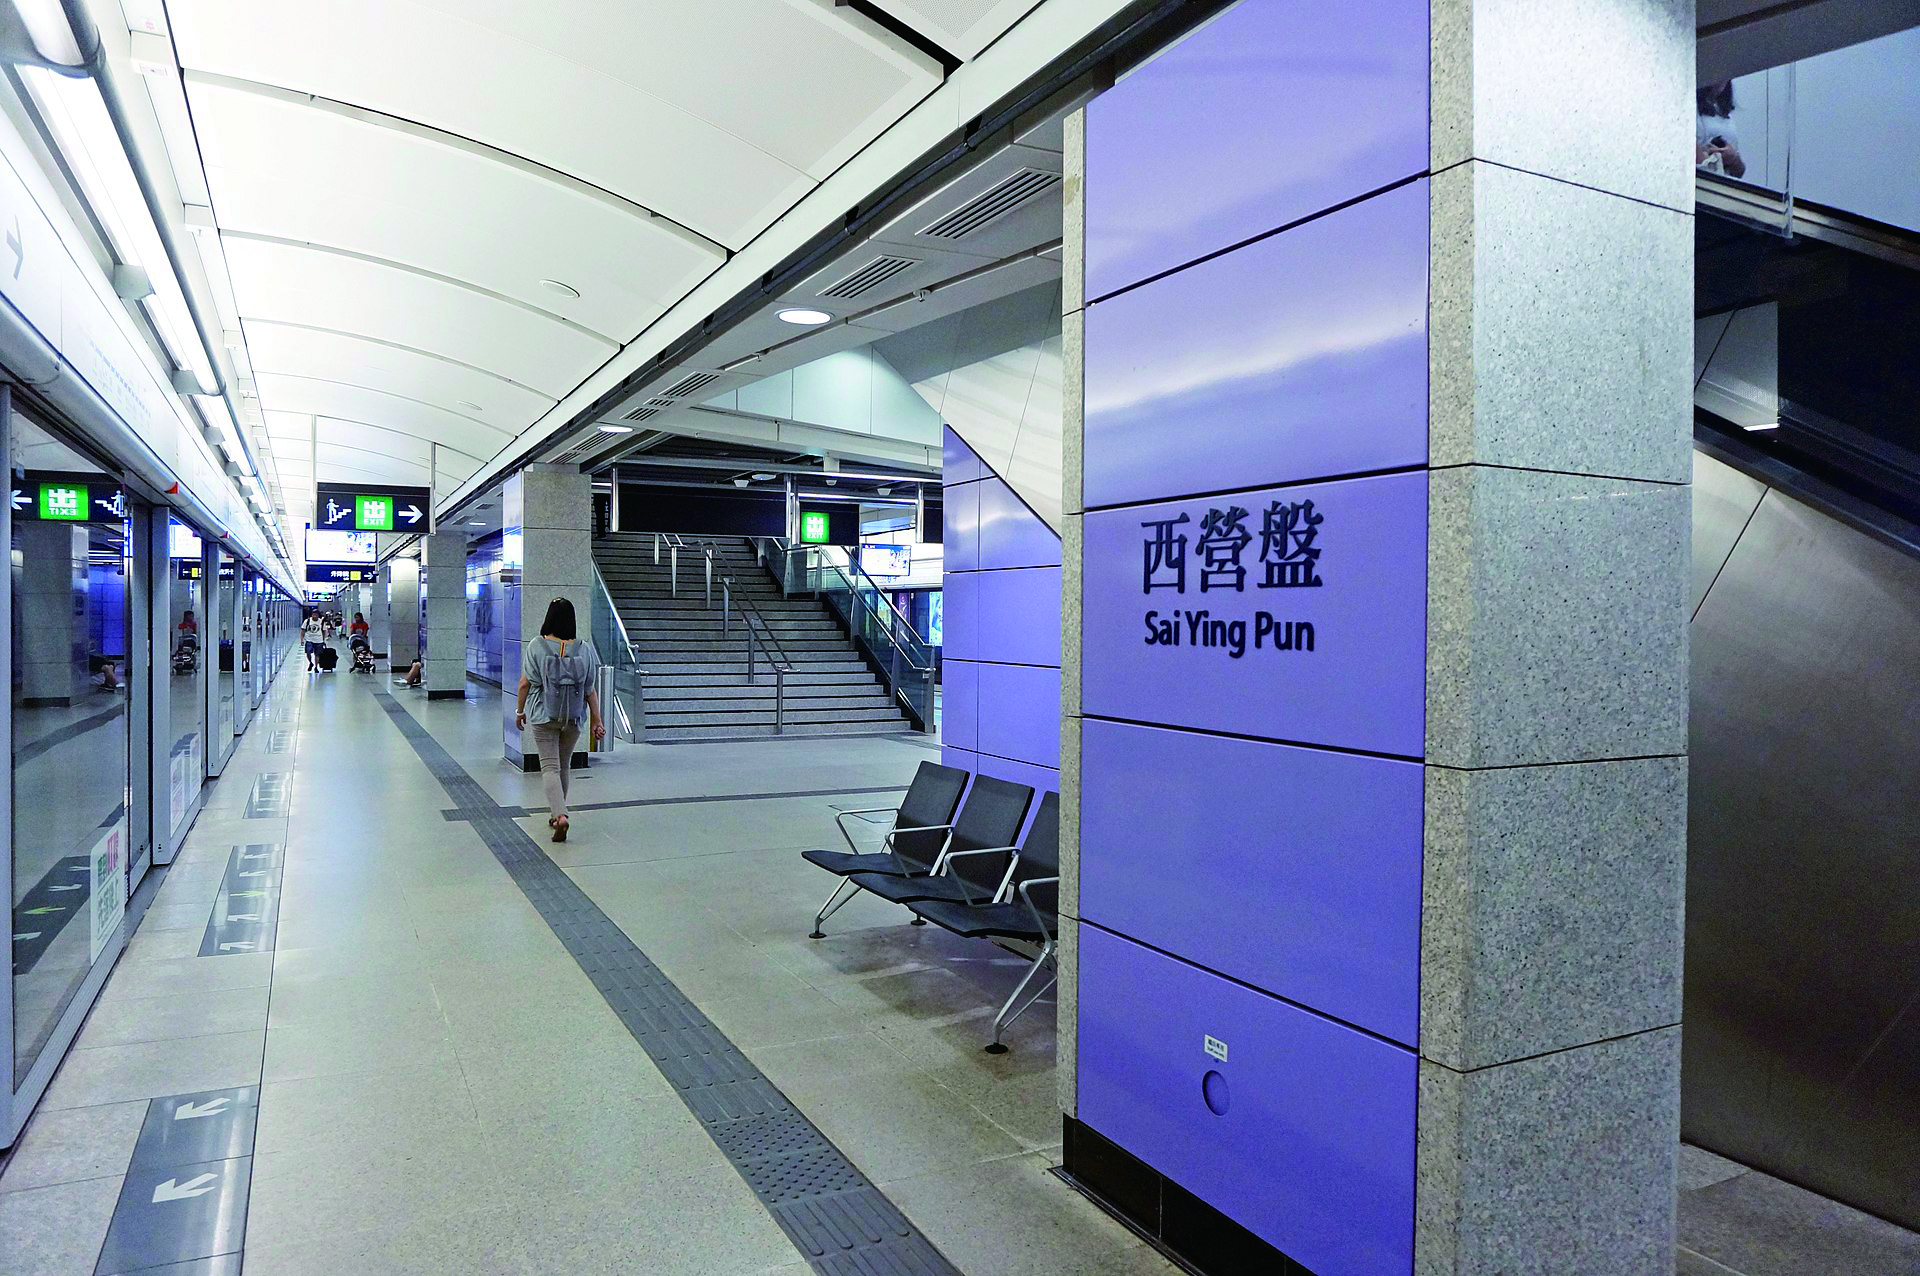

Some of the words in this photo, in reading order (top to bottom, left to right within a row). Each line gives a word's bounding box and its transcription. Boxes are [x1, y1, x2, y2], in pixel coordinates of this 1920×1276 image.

[363, 501, 386, 518] 出
[363, 518, 385, 526] EXIT
[806, 516, 824, 532] 出
[1141, 499, 1324, 594] 西營盤
[1144, 610, 1180, 646] Sai
[1185, 610, 1246, 659] Ying
[1255, 611, 1315, 651] Pun
